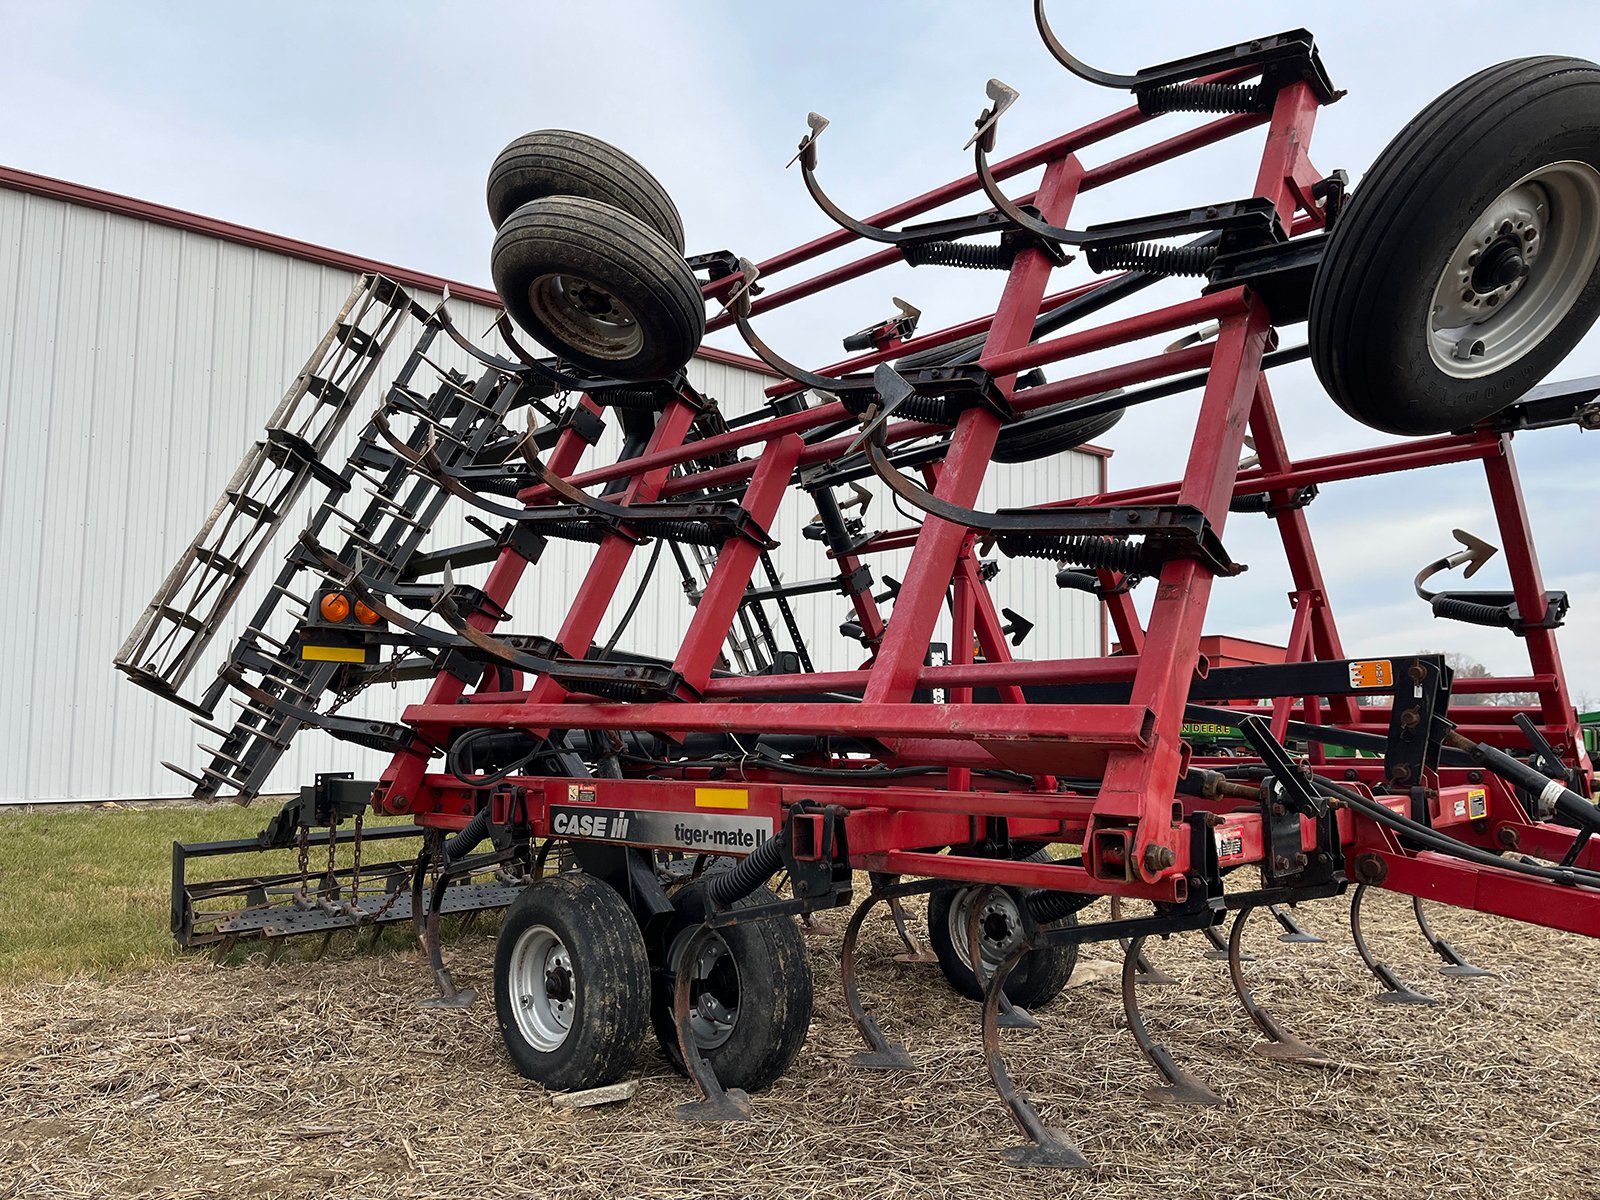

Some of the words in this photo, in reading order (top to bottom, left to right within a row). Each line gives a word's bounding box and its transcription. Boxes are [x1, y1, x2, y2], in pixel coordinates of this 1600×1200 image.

[1192, 723, 1231, 735] DEERE
[553, 813, 608, 838] CASE
[674, 823, 754, 847] tiger-mate
